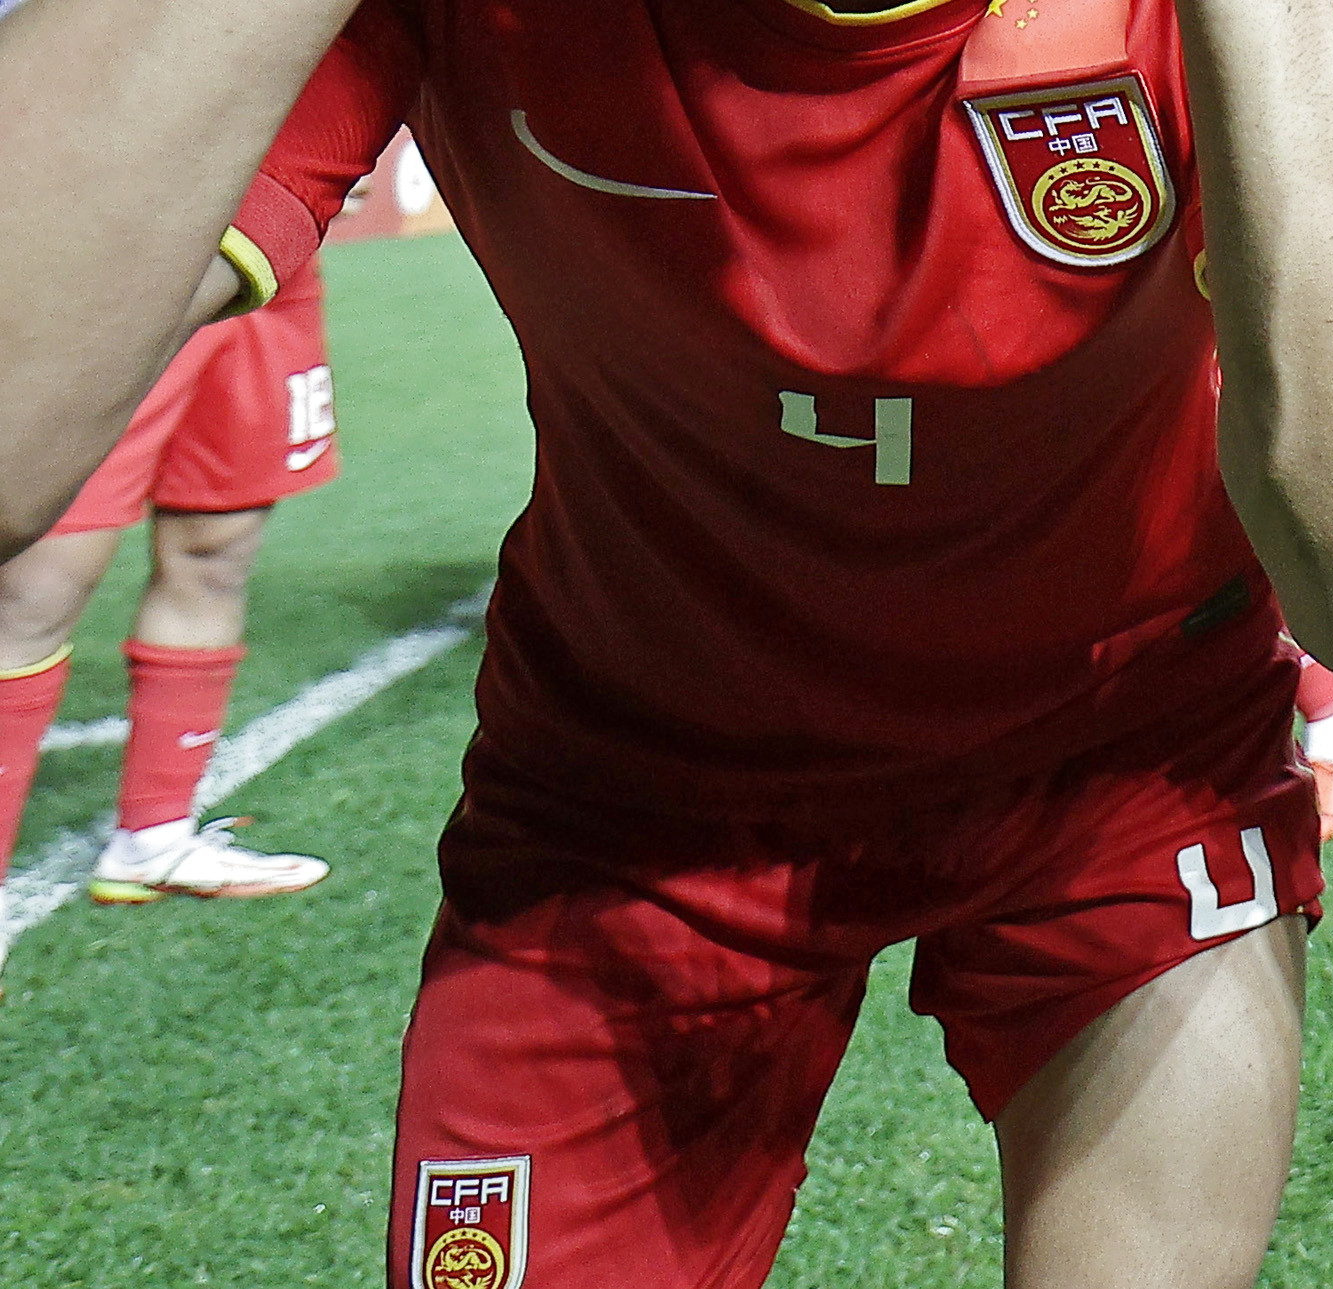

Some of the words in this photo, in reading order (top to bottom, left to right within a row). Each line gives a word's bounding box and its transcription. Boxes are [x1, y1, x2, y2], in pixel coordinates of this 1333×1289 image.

[999, 96, 1128, 140] CFA
[1048, 133, 1098, 156] 中国
[778, 390, 912, 485] 4
[430, 1176, 509, 1206] CFA
[450, 1207, 481, 1225] 中国
